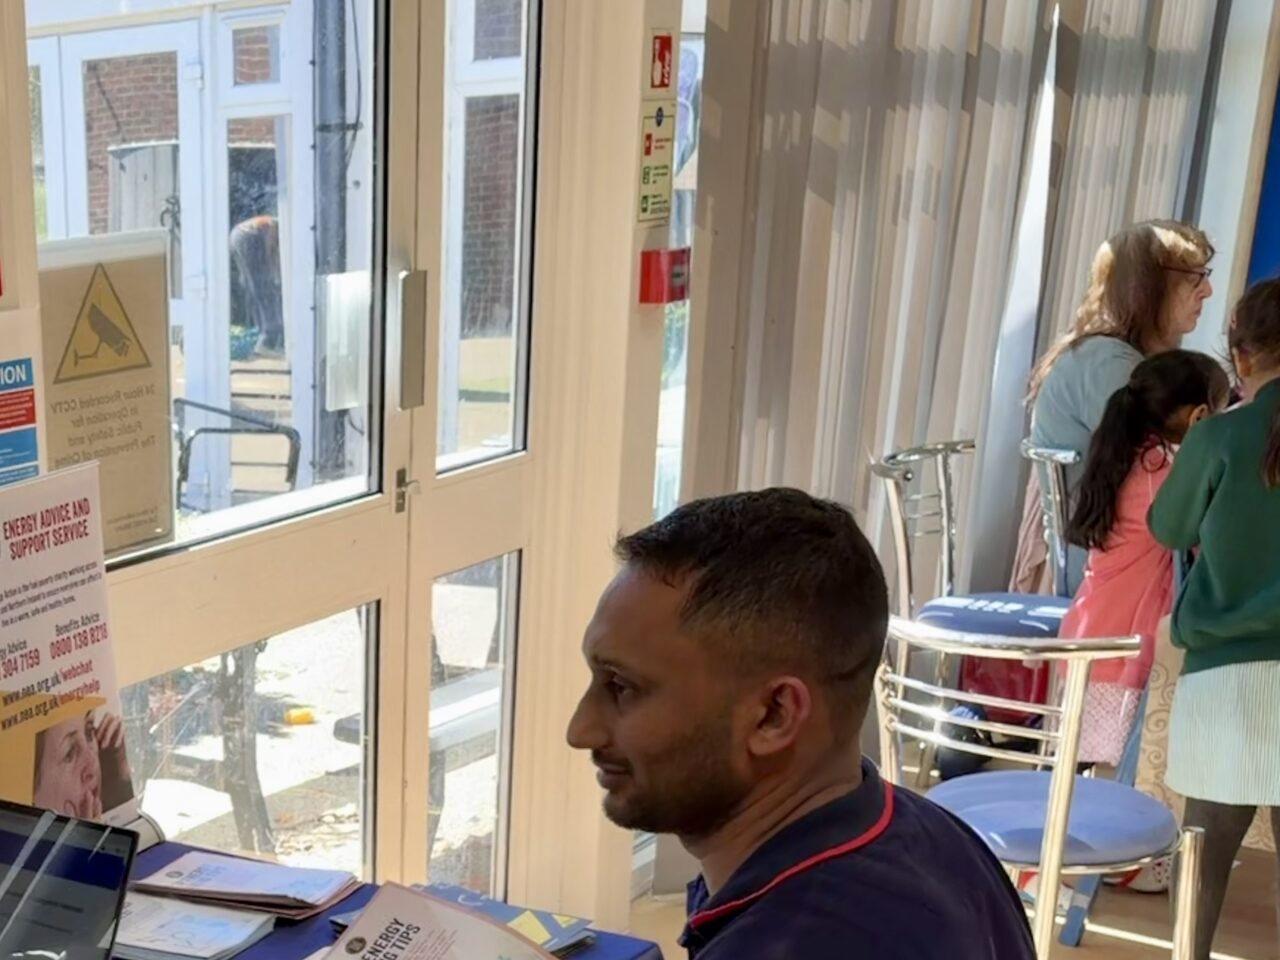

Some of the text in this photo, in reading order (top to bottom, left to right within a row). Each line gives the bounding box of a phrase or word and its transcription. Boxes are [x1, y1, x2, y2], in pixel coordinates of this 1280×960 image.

[2, 497, 90, 540] ENERGY ADVICE AND
[9, 531, 51, 561] SUPPORT
[52, 519, 90, 547] SERVICE
[55, 612, 100, 637] Benefits Advice
[7, 640, 28, 655] Advice
[49, 635, 73, 660] 0800
[73, 629, 89, 650] 138
[1, 656, 19, 679] 304
[19, 648, 40, 672] 7159
[391, 923, 421, 951] TIPS
